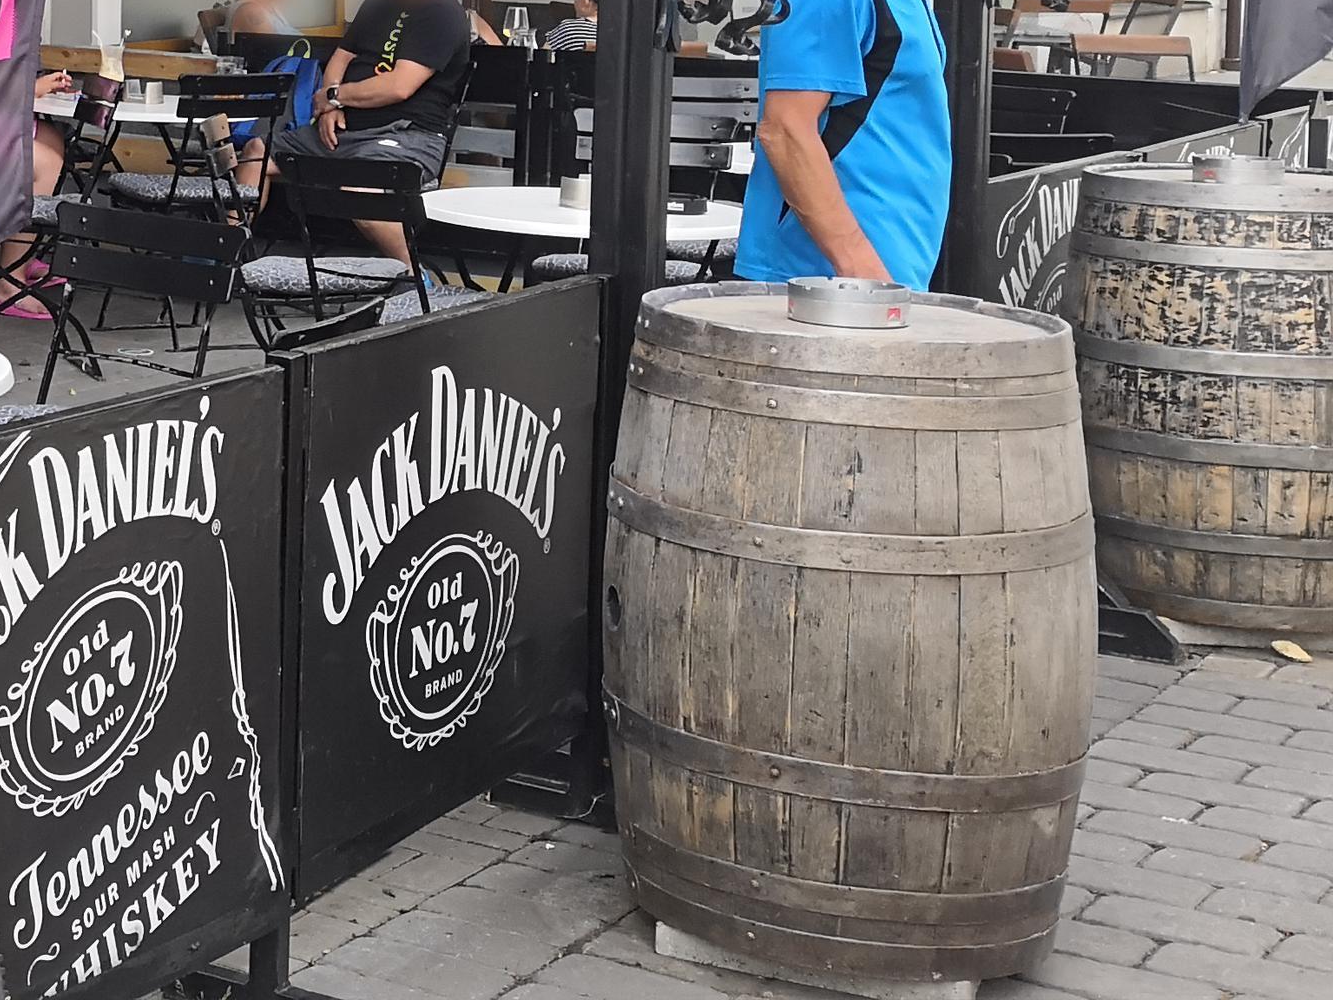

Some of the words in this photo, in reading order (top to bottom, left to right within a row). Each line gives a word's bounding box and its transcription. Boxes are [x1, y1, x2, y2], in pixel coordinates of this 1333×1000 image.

[998, 217, 1043, 307] JACK
[28, 395, 225, 579] DANIEL'S
[319, 411, 426, 625] JACK
[428, 365, 566, 539] DANIEL'S
[428, 572, 463, 609] Old
[63, 619, 111, 676] Old
[425, 668, 463, 699] BRAND
[76, 704, 125, 757] BRAND
[8, 731, 213, 950] Tennessee
[71, 882, 120, 941] SOUR
[125, 826, 176, 887] MASH
